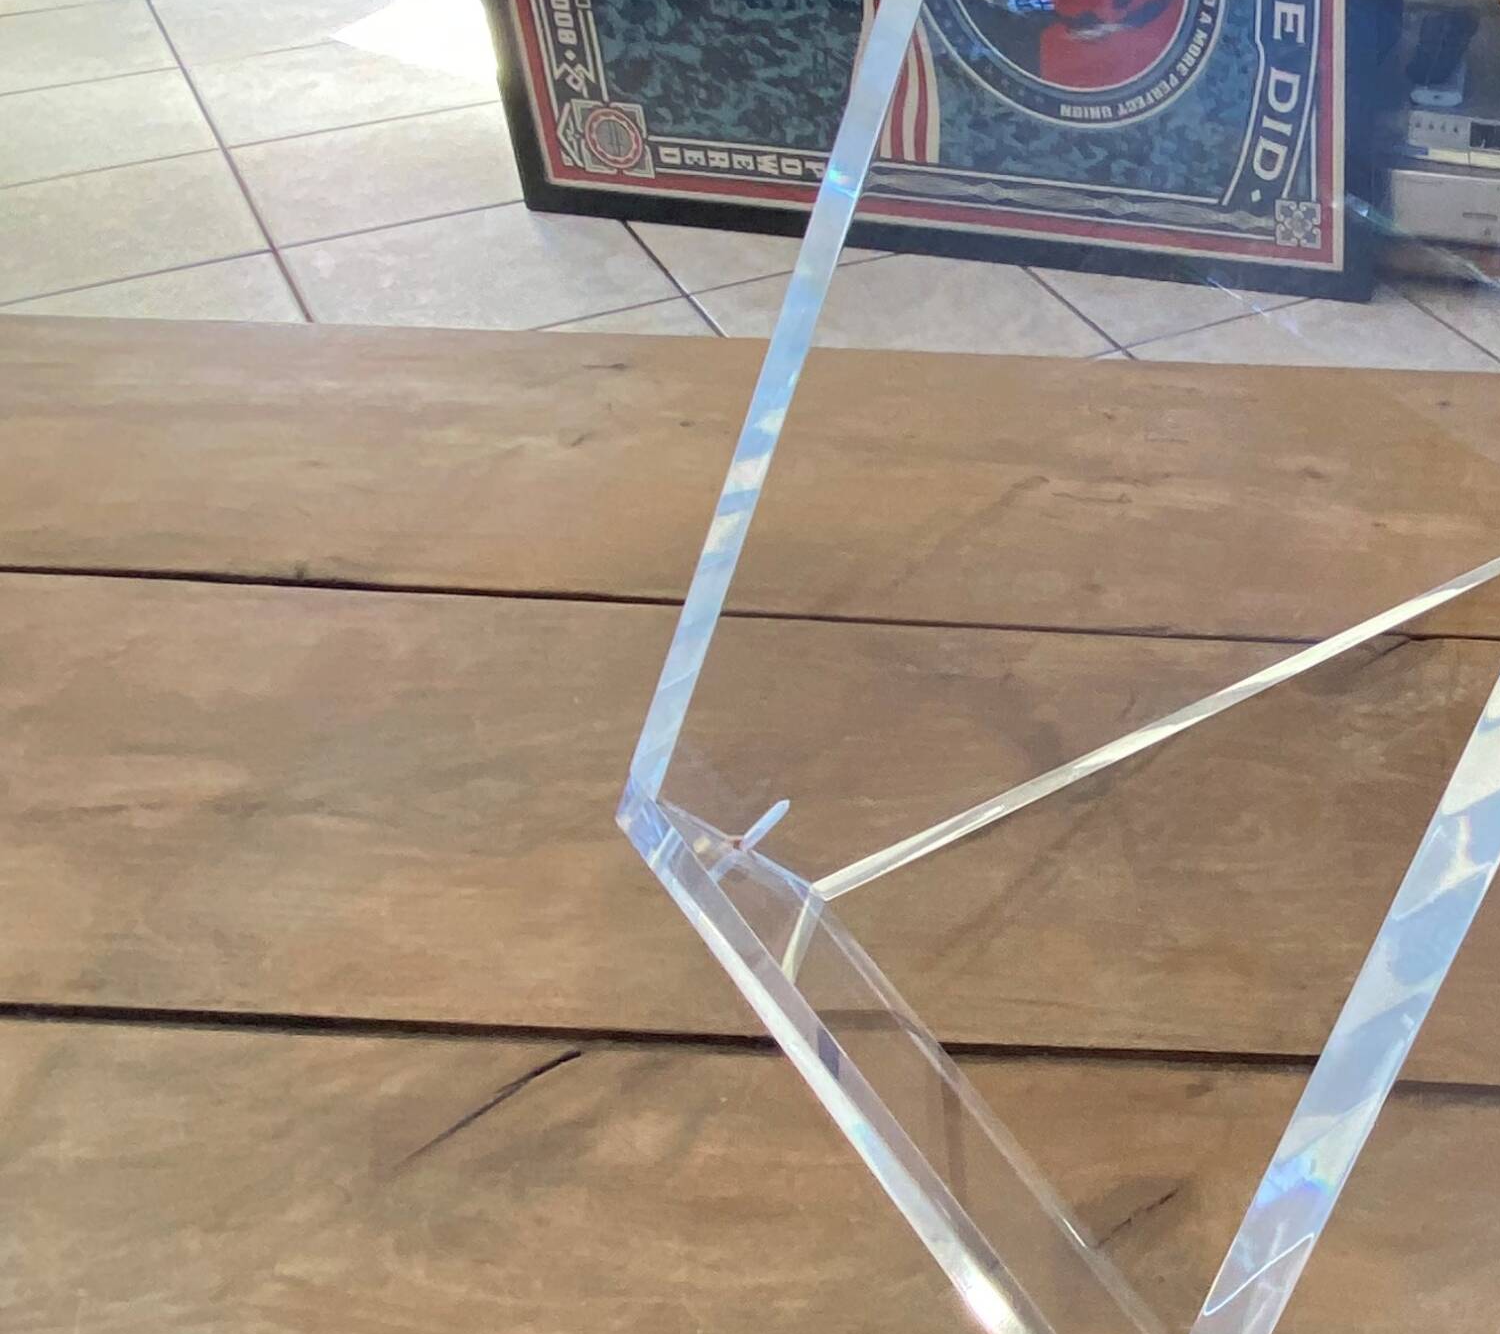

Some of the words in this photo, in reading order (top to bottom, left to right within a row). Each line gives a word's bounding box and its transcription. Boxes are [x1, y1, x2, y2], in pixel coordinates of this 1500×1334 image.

[1200, 11, 1213, 25] A
[1176, 28, 1209, 77] MORE
[1060, 103, 1113, 120] UNION
[1117, 72, 1180, 116] PERFECT
[1253, 67, 1300, 182] DID
[658, 145, 829, 179] POWERED
